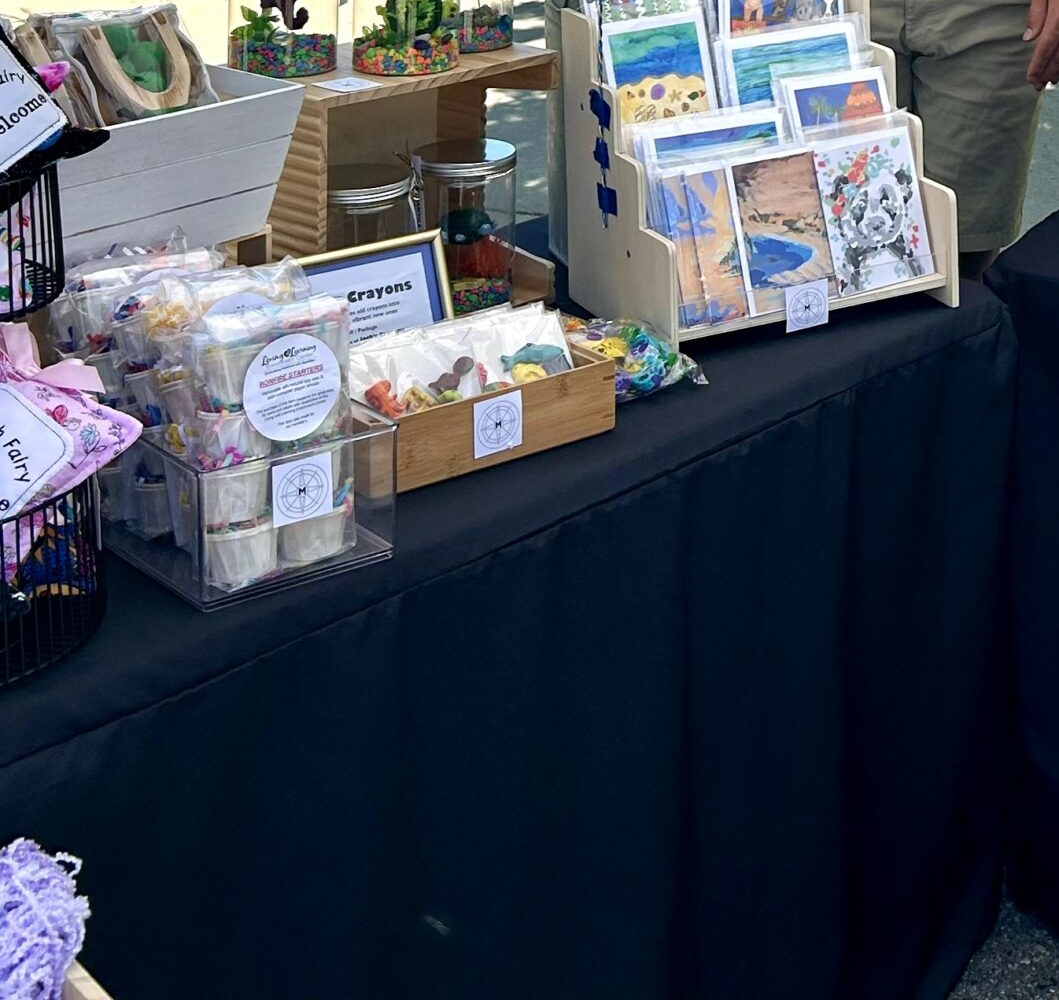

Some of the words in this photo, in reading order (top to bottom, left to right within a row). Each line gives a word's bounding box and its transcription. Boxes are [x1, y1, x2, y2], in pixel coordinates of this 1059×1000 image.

[347, 280, 413, 303] Crayons
[288, 364, 324, 379] STARTERS
[494, 420, 502, 428] M
[299, 487, 306, 495] M
